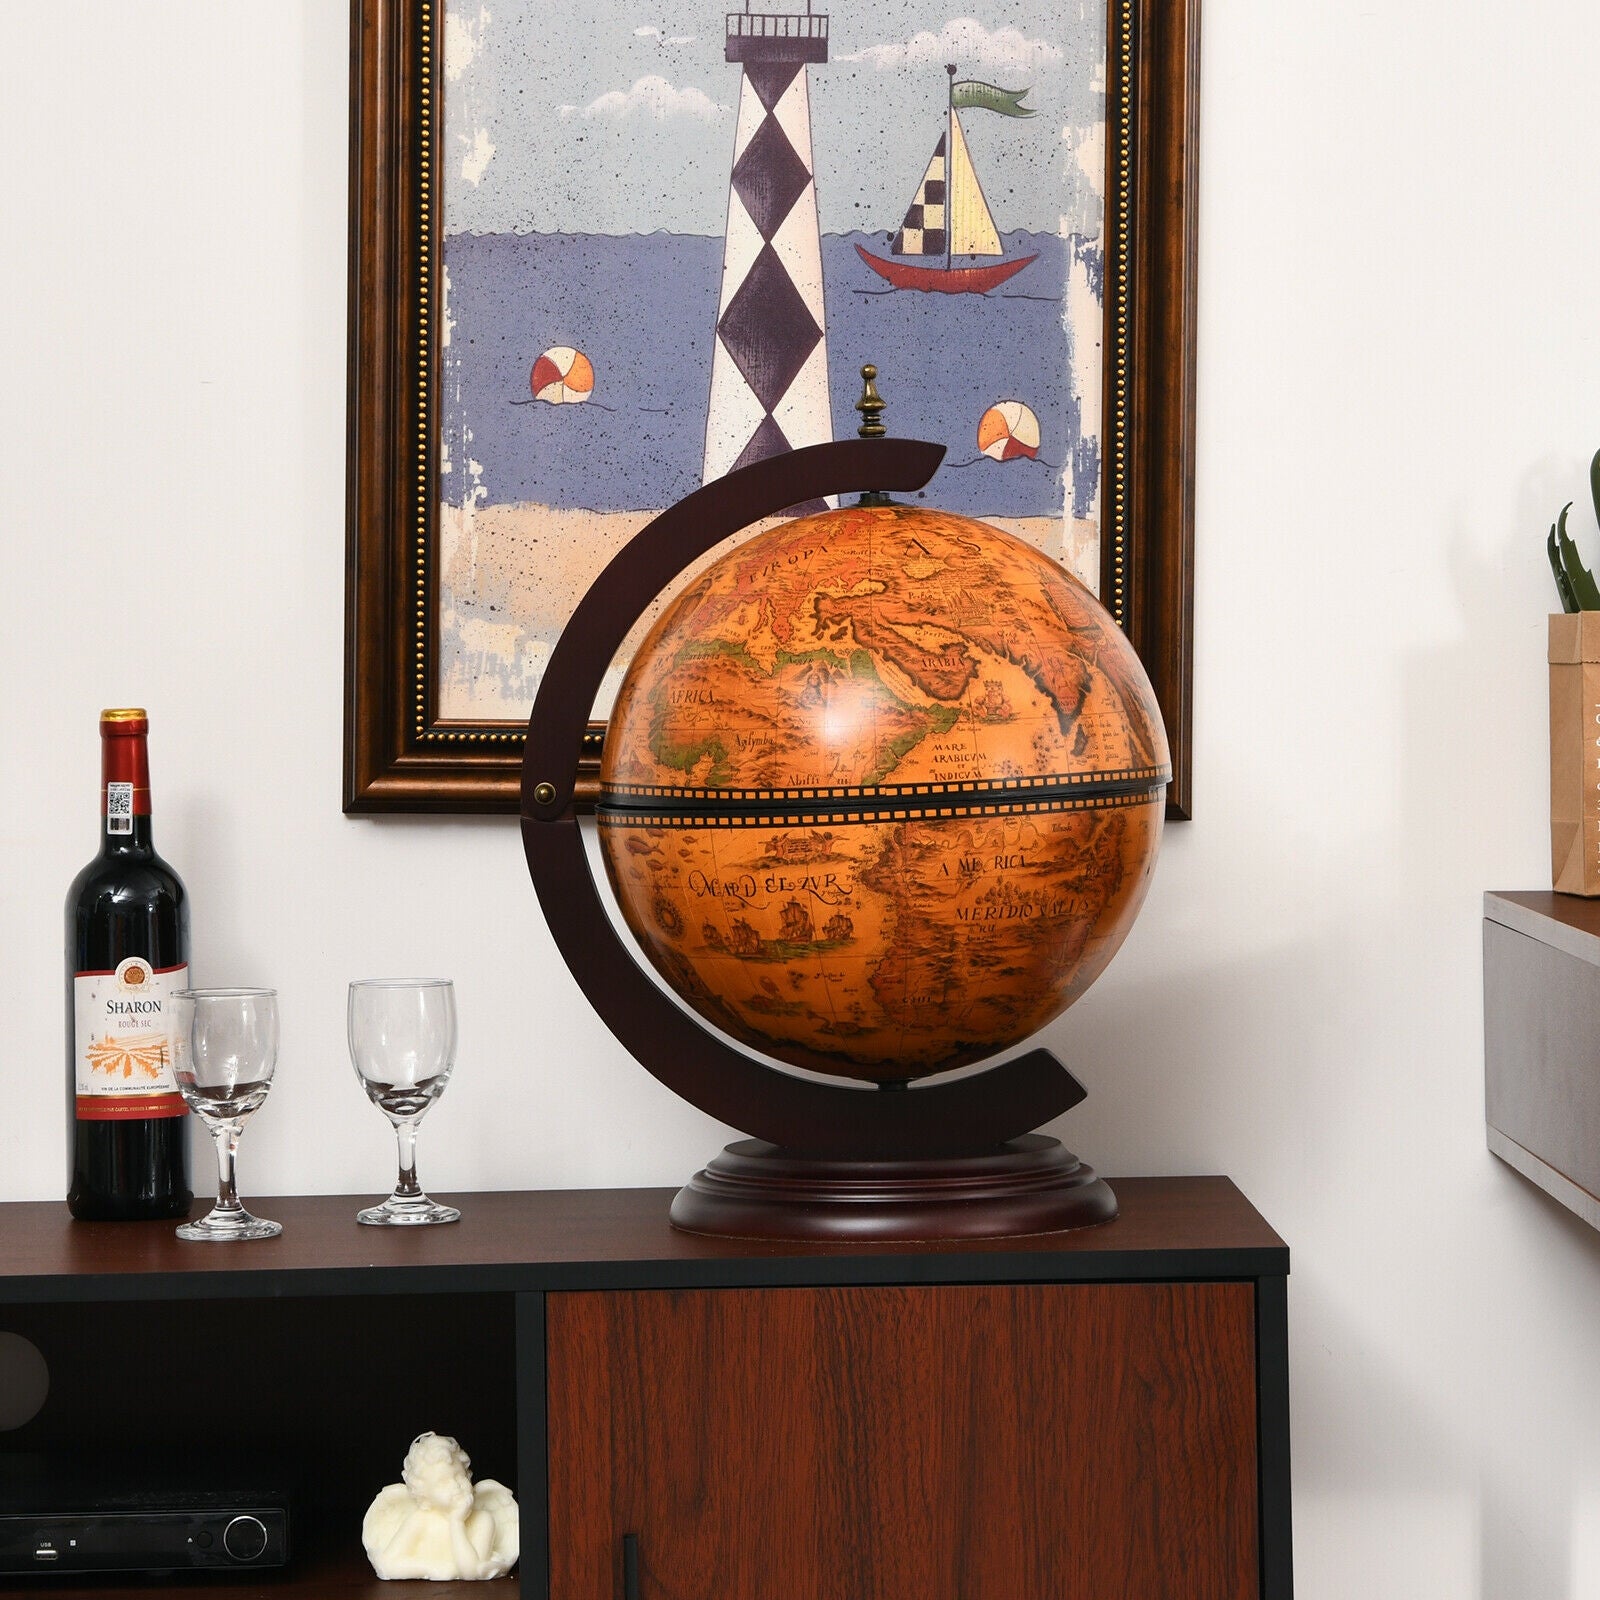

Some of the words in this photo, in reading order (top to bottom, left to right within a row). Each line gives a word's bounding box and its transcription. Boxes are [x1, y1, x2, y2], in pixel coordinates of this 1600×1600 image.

[932, 743, 967, 752] MARE
[934, 770, 982, 782] INDICVM
[106, 1000, 162, 1014] SHARON
[118, 1020, 139, 1028] ROUGE
[141, 1020, 152, 1028] SEC
